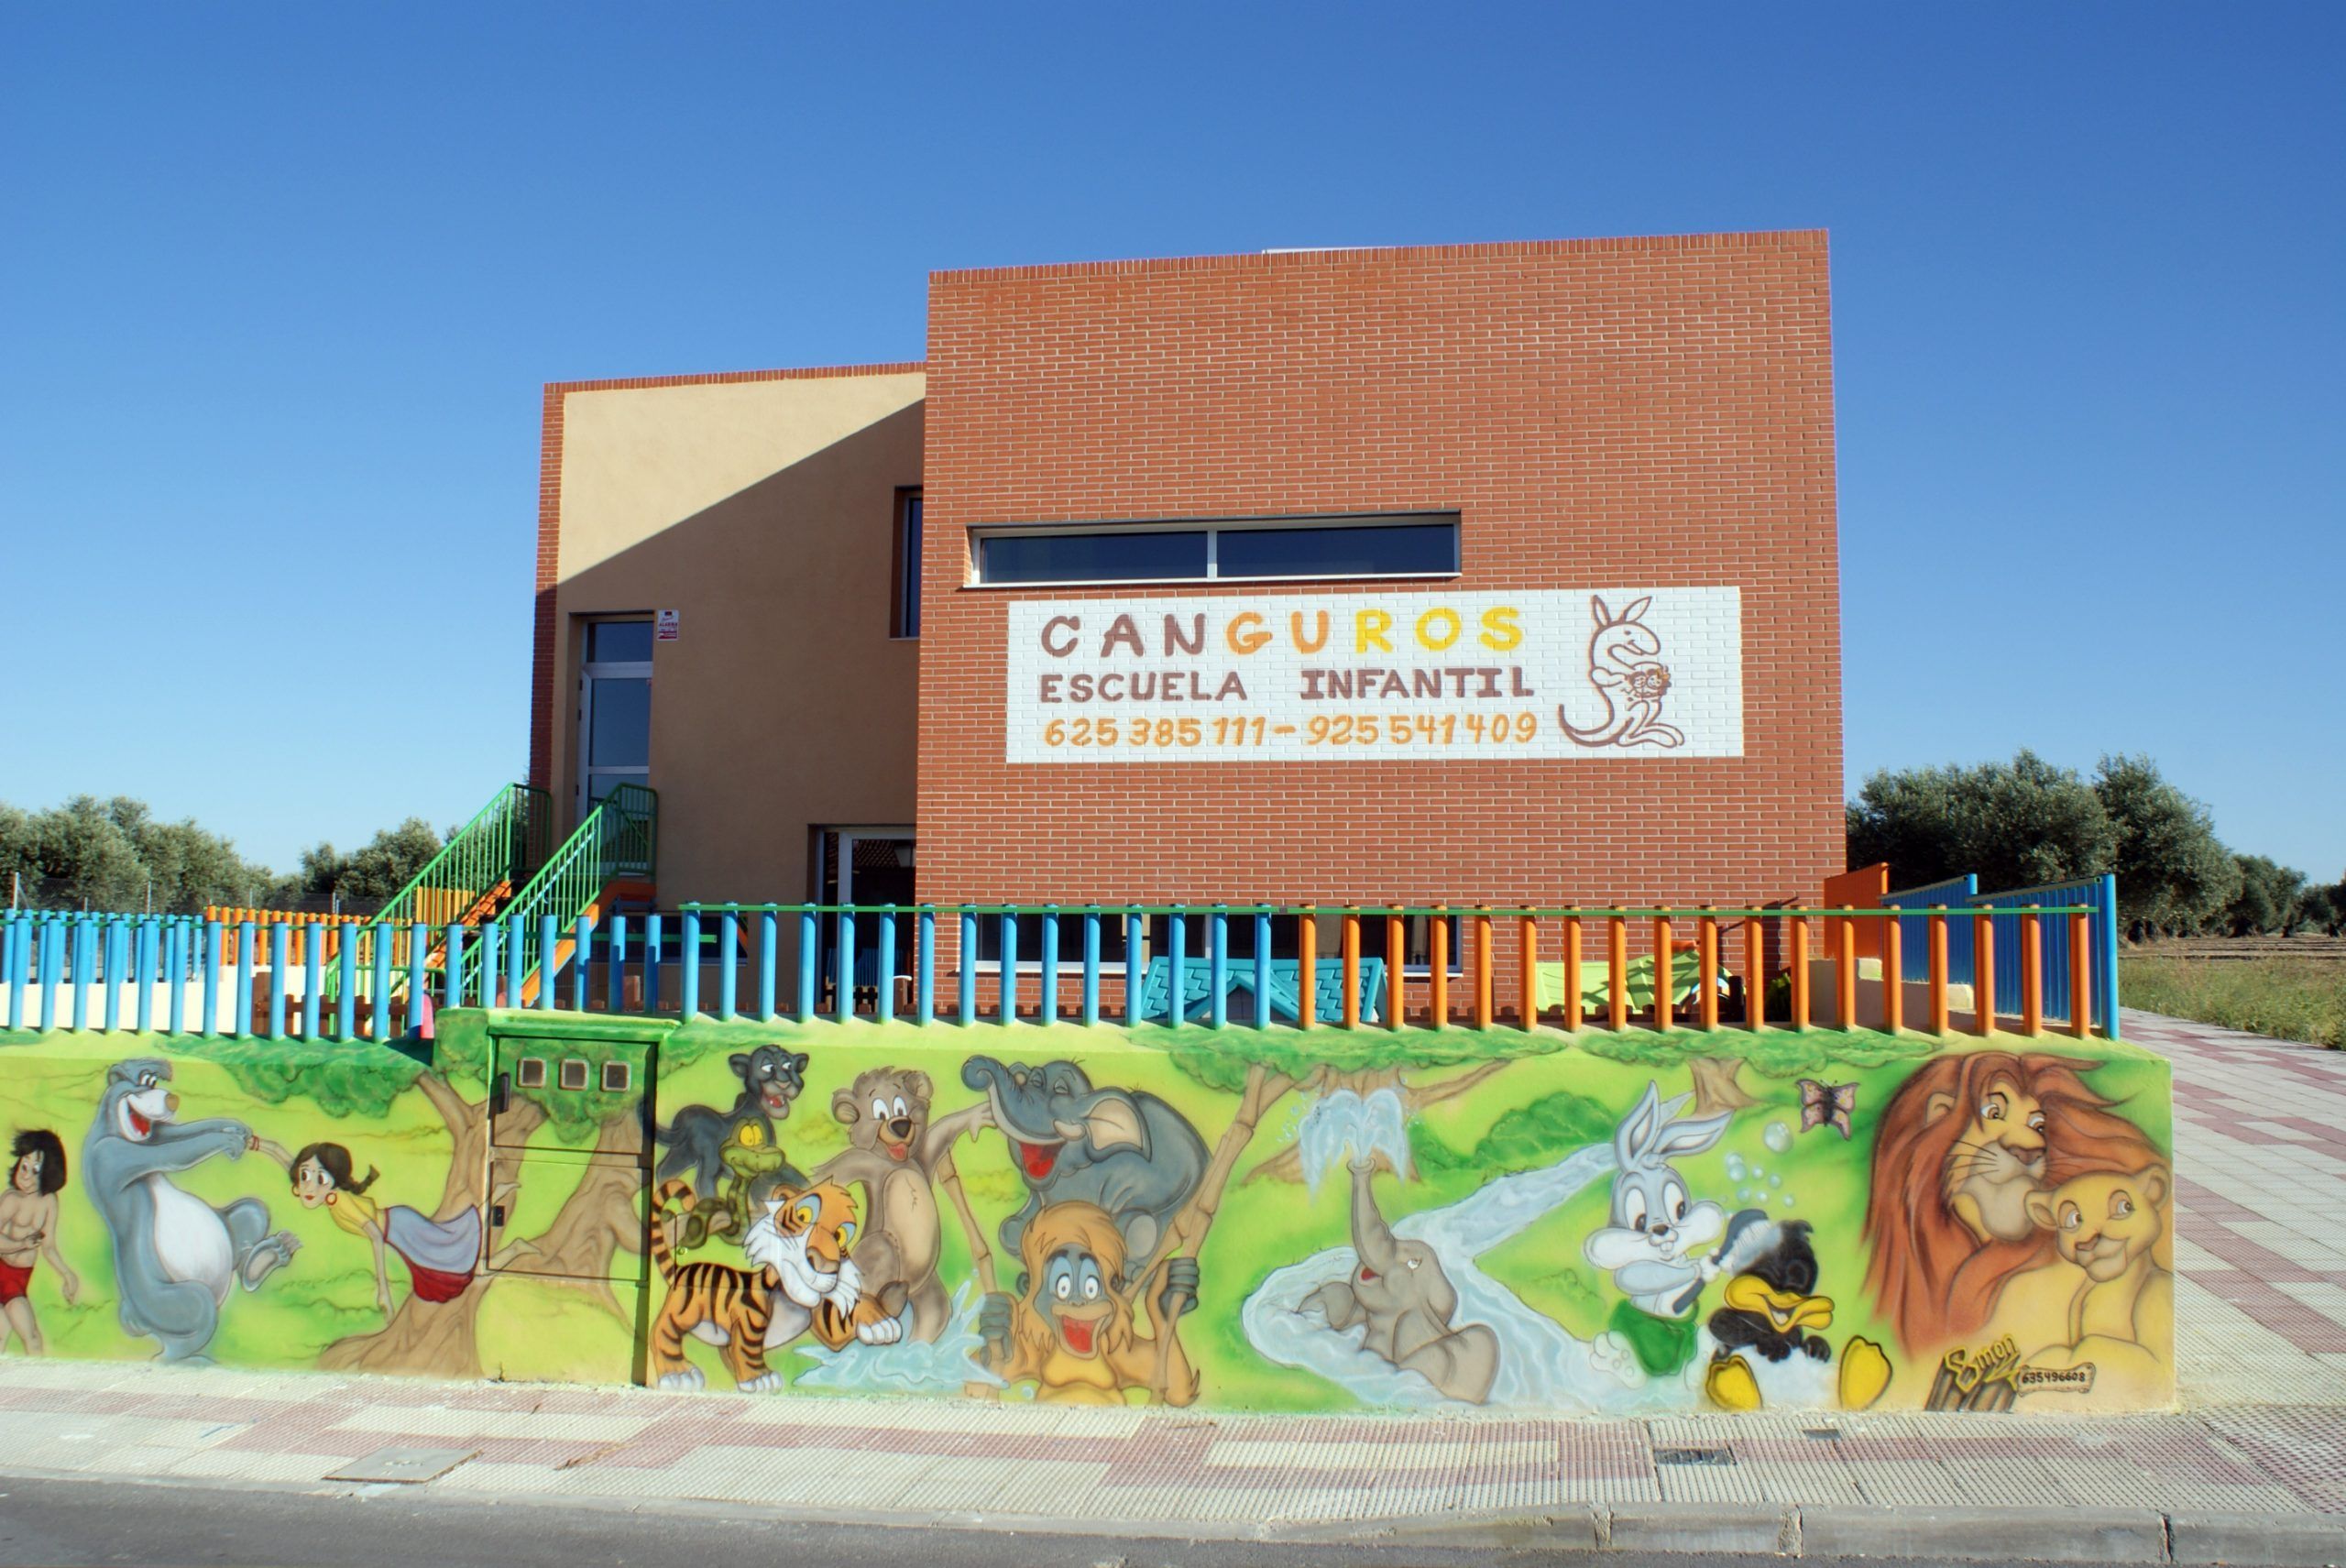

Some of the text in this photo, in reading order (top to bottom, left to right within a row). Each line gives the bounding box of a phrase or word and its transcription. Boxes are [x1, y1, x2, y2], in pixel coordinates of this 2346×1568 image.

[1041, 608, 1524, 659] CANGUROS
[1040, 666, 1535, 703] ESCUELA INFANTIL
[2022, 1371, 2086, 1384] 635496608
